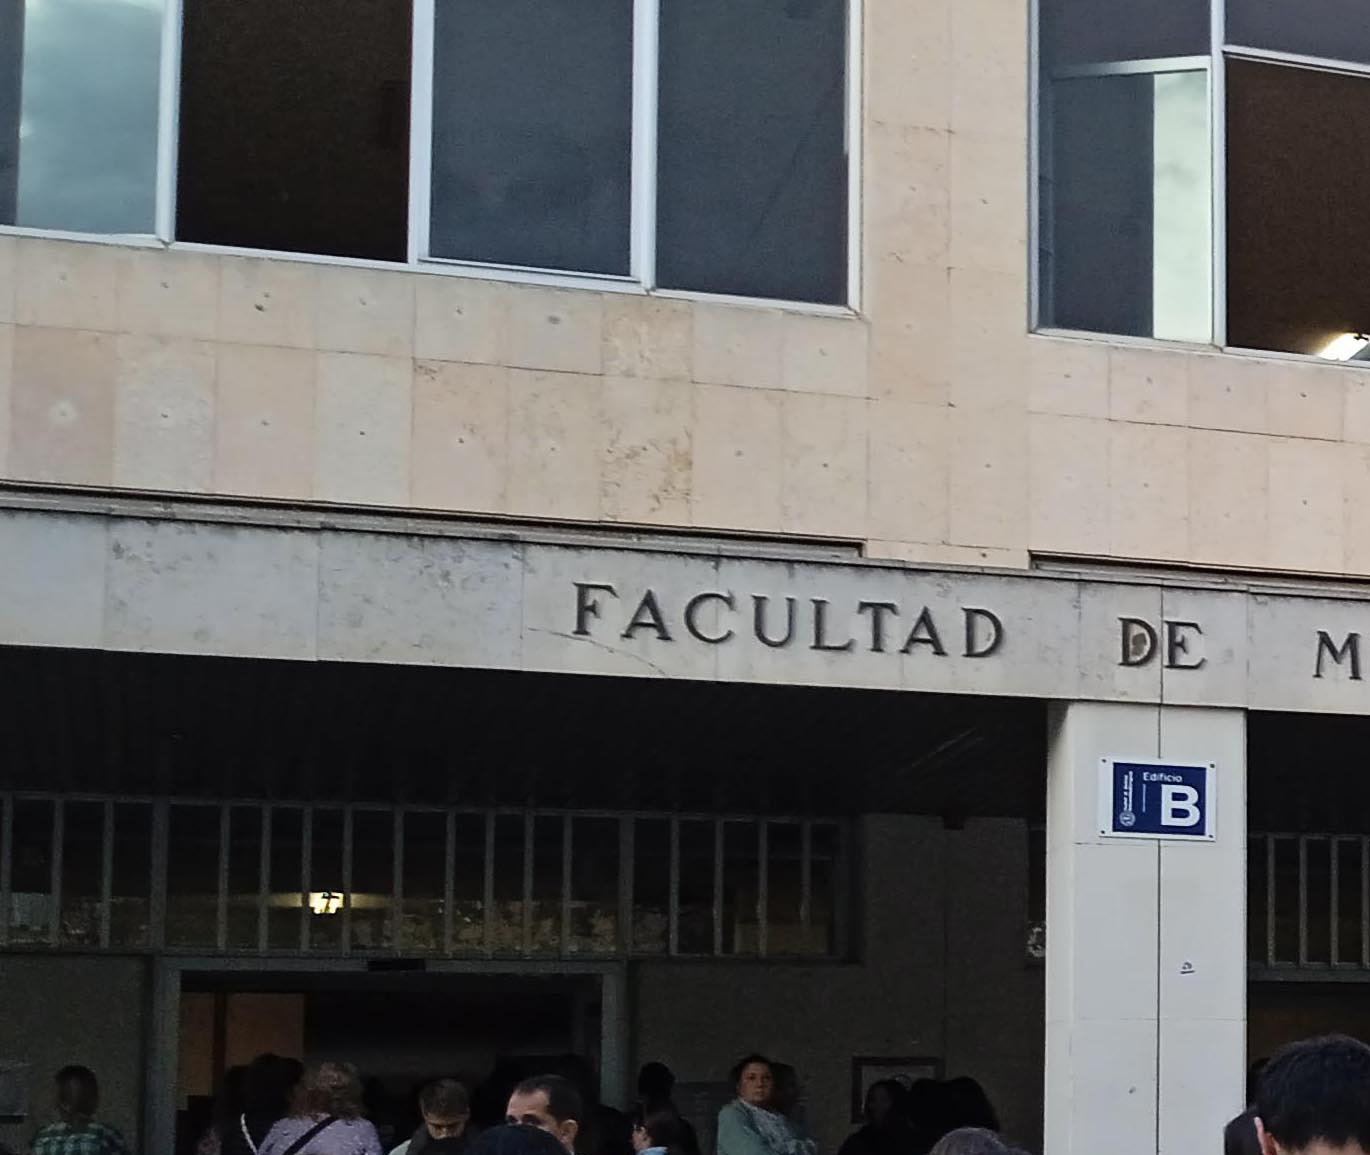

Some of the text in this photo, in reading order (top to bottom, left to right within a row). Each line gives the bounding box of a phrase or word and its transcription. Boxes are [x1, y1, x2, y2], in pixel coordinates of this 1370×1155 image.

[572, 581, 1006, 658] FACULTAD
[1117, 616, 1207, 670] DE
[1142, 771, 1183, 783] Edificio
[1160, 783, 1201, 827] B
